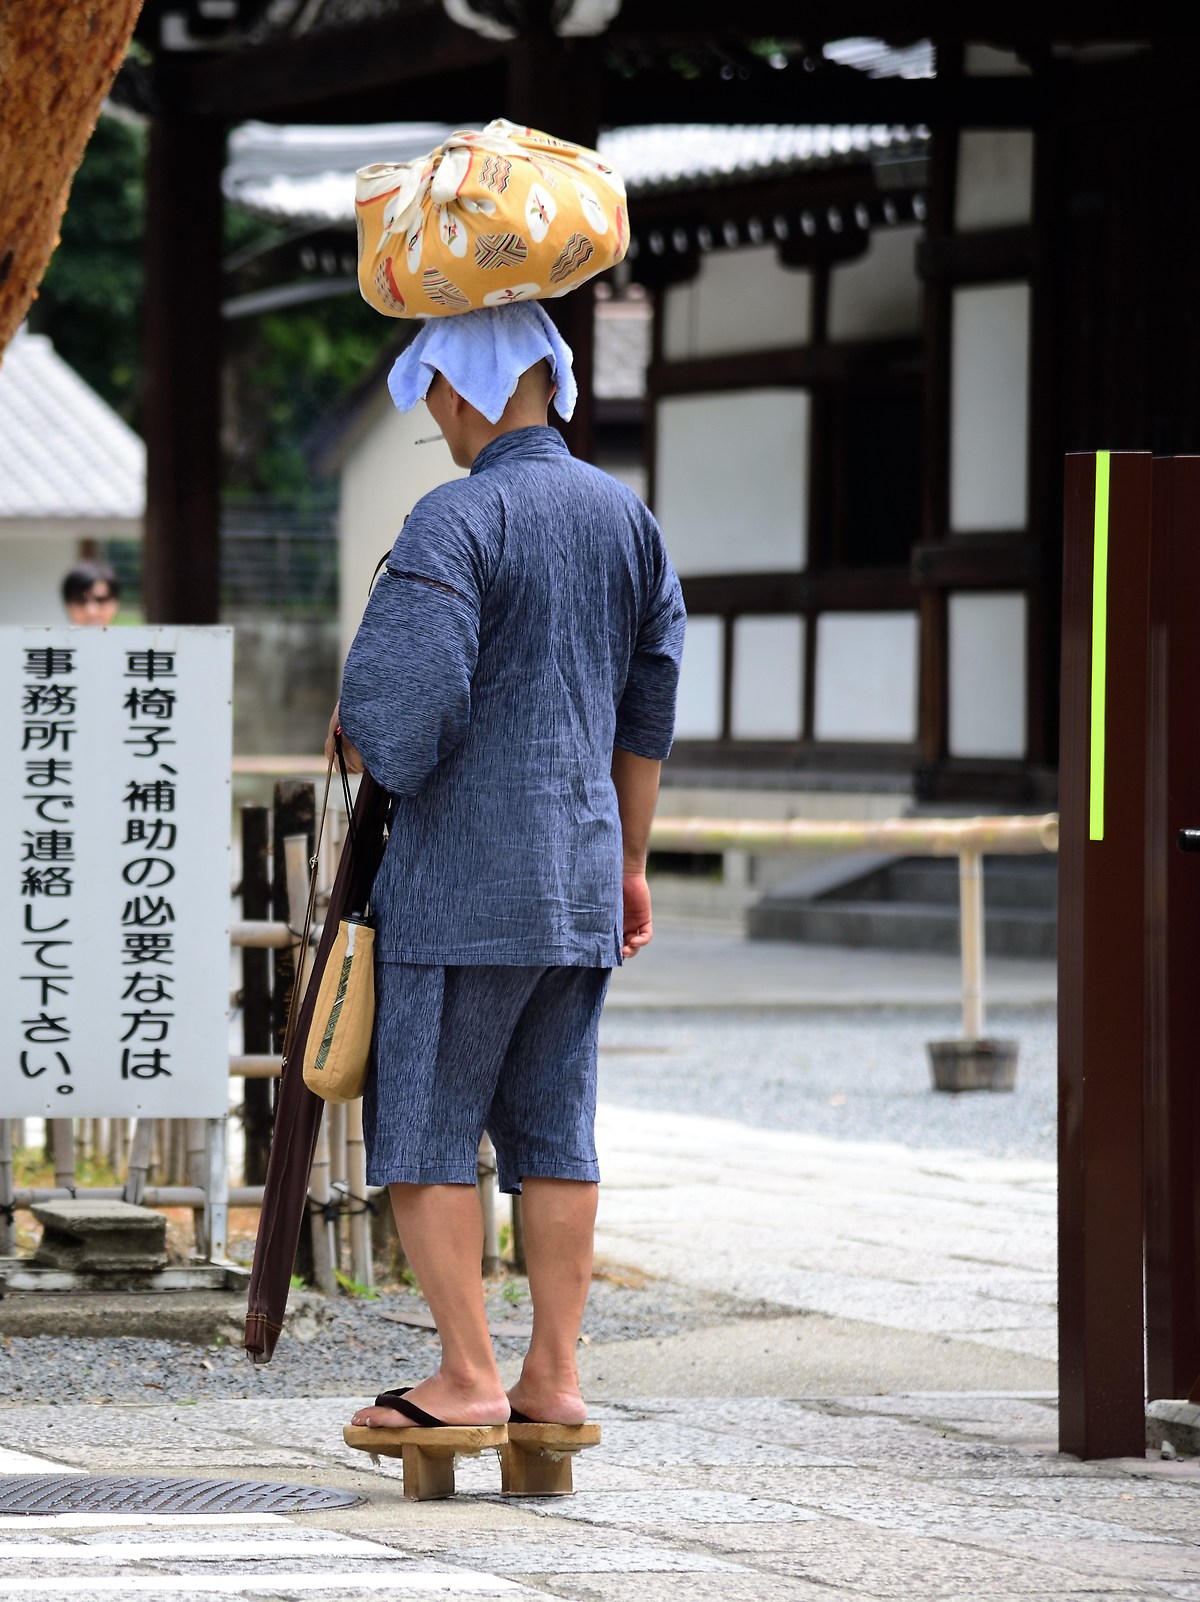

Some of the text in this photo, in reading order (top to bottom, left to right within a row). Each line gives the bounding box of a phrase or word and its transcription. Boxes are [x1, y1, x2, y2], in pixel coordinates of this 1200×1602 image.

[19, 646, 77, 1096] 事務所まで連絡して下さい。
[120, 648, 178, 1080] 車椅子、補助の必要な方は
